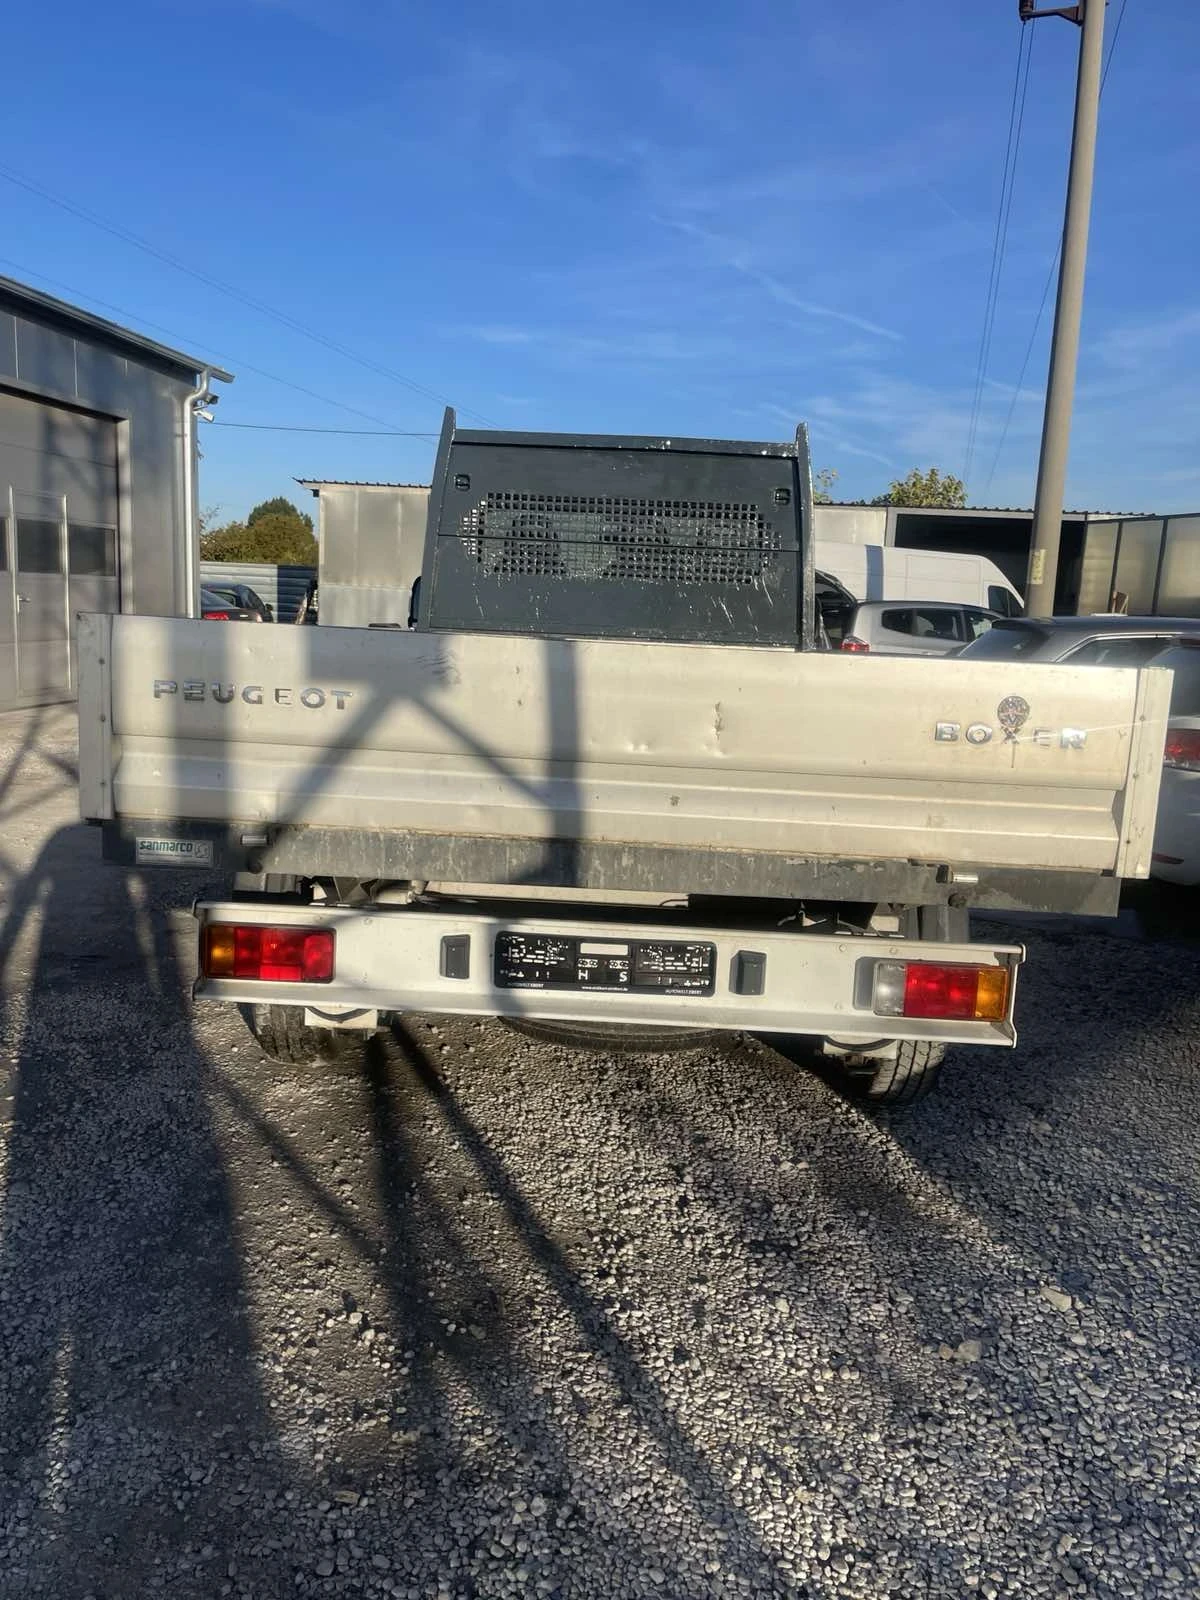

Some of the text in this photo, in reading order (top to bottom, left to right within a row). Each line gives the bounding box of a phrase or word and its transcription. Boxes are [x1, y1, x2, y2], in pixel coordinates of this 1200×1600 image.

[153, 680, 353, 710] PEUGEOT
[935, 720, 1088, 750] BOXER
[139, 840, 193, 852] sanmarco
